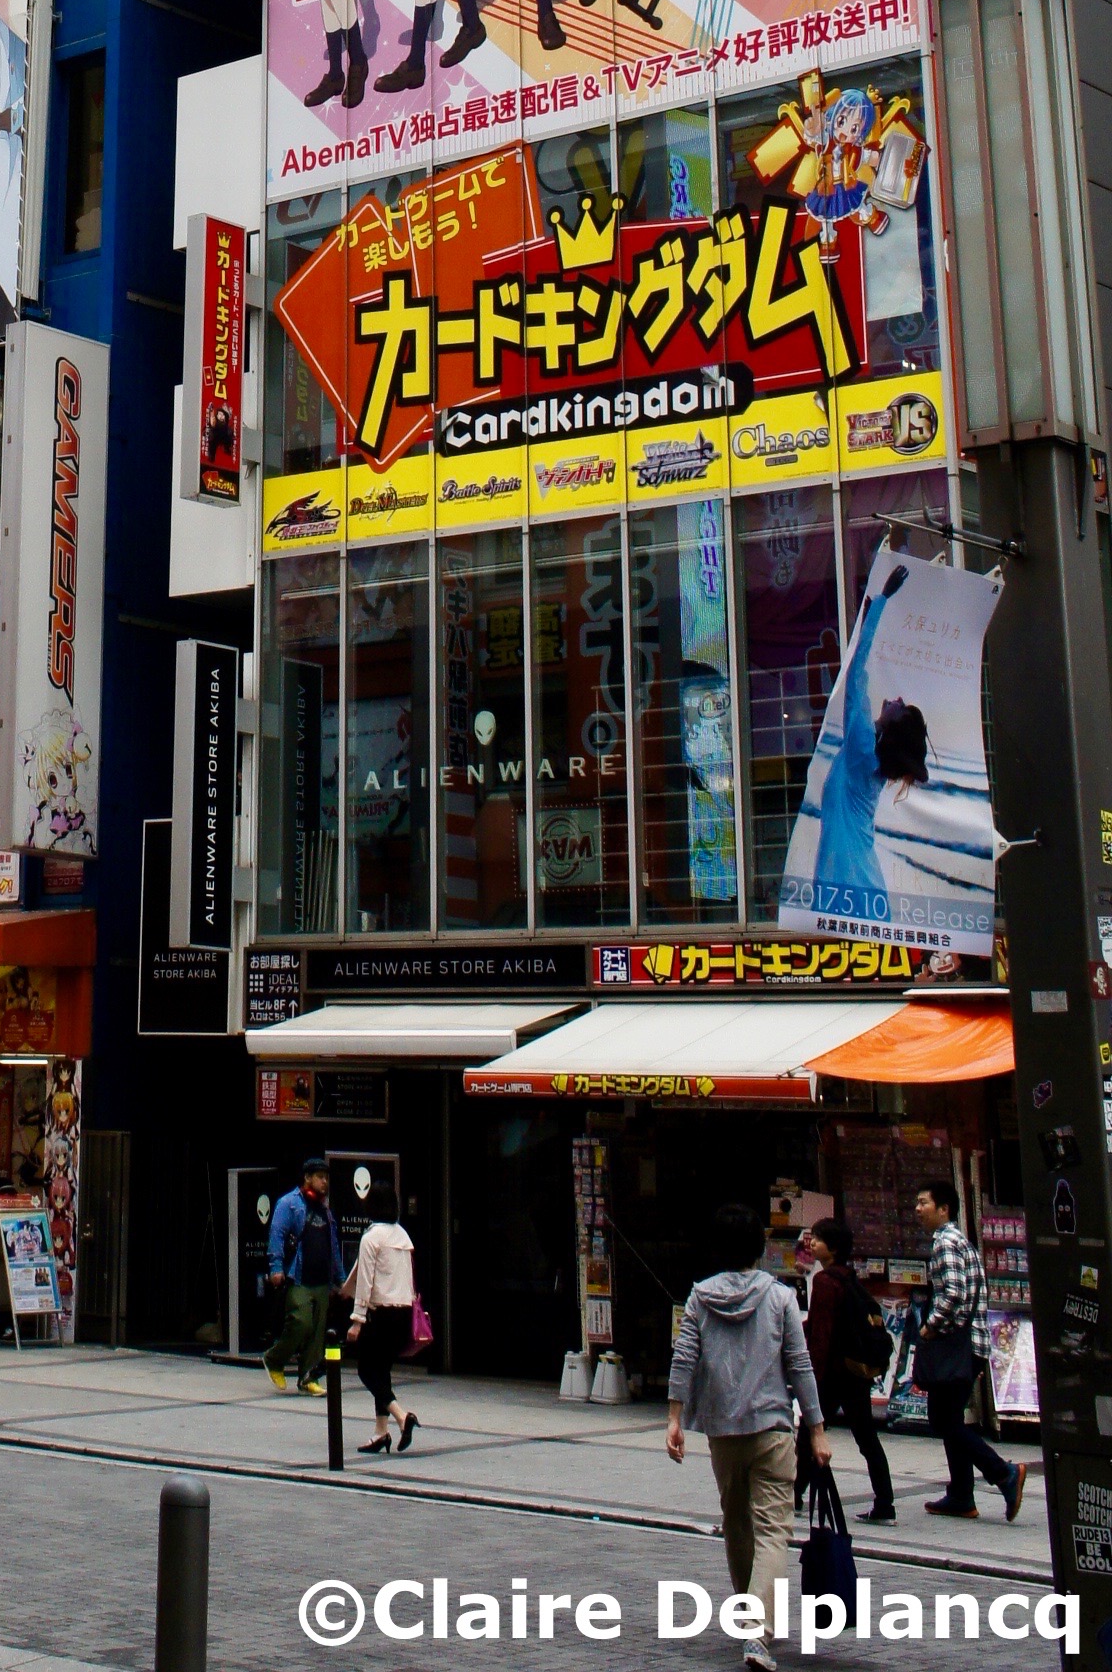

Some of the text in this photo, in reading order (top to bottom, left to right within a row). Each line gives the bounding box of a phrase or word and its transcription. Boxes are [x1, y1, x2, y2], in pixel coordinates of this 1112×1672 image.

[336, 158, 507, 253] カードゲームで
[363, 206, 479, 274] 楽しもう!
[214, 250, 231, 401] カードキングダム
[356, 197, 858, 458] カードキングダム
[893, 402, 932, 447] VS
[732, 423, 830, 460] Chaos
[438, 475, 522, 504] Battle Spirits
[49, 356, 82, 706] GAMERS
[363, 754, 618, 791] ALIENWARE
[205, 667, 221, 926] ALIENWARE STORE AKIBA
[785, 880, 989, 931] 2017.5.10 Release
[816, 916, 952, 949] 秋葉原駅前商店街振興組合
[153, 952, 218, 963] ALIENWARE
[249, 954, 300, 969] お部屋探し
[601, 949, 627, 960] カード
[601, 960, 627, 971] ゲーム
[681, 940, 912, 981] カードキングダム
[153, 968, 217, 979] STORE AKIBA
[334, 958, 558, 976] ALIENWARE STORE AKIBA
[268, 973, 299, 985] iDEAL
[268, 985, 299, 993] アイデアル
[249, 999, 286, 1011] 当ビル 8F
[249, 1012, 287, 1022] 入口はこちら
[470, 1081, 533, 1094] カードゲーム専門店
[574, 1074, 691, 1096] カードキングダム
[1074, 1526, 1110, 1545] RUDE13
[1085, 1542, 1102, 1558] BE
